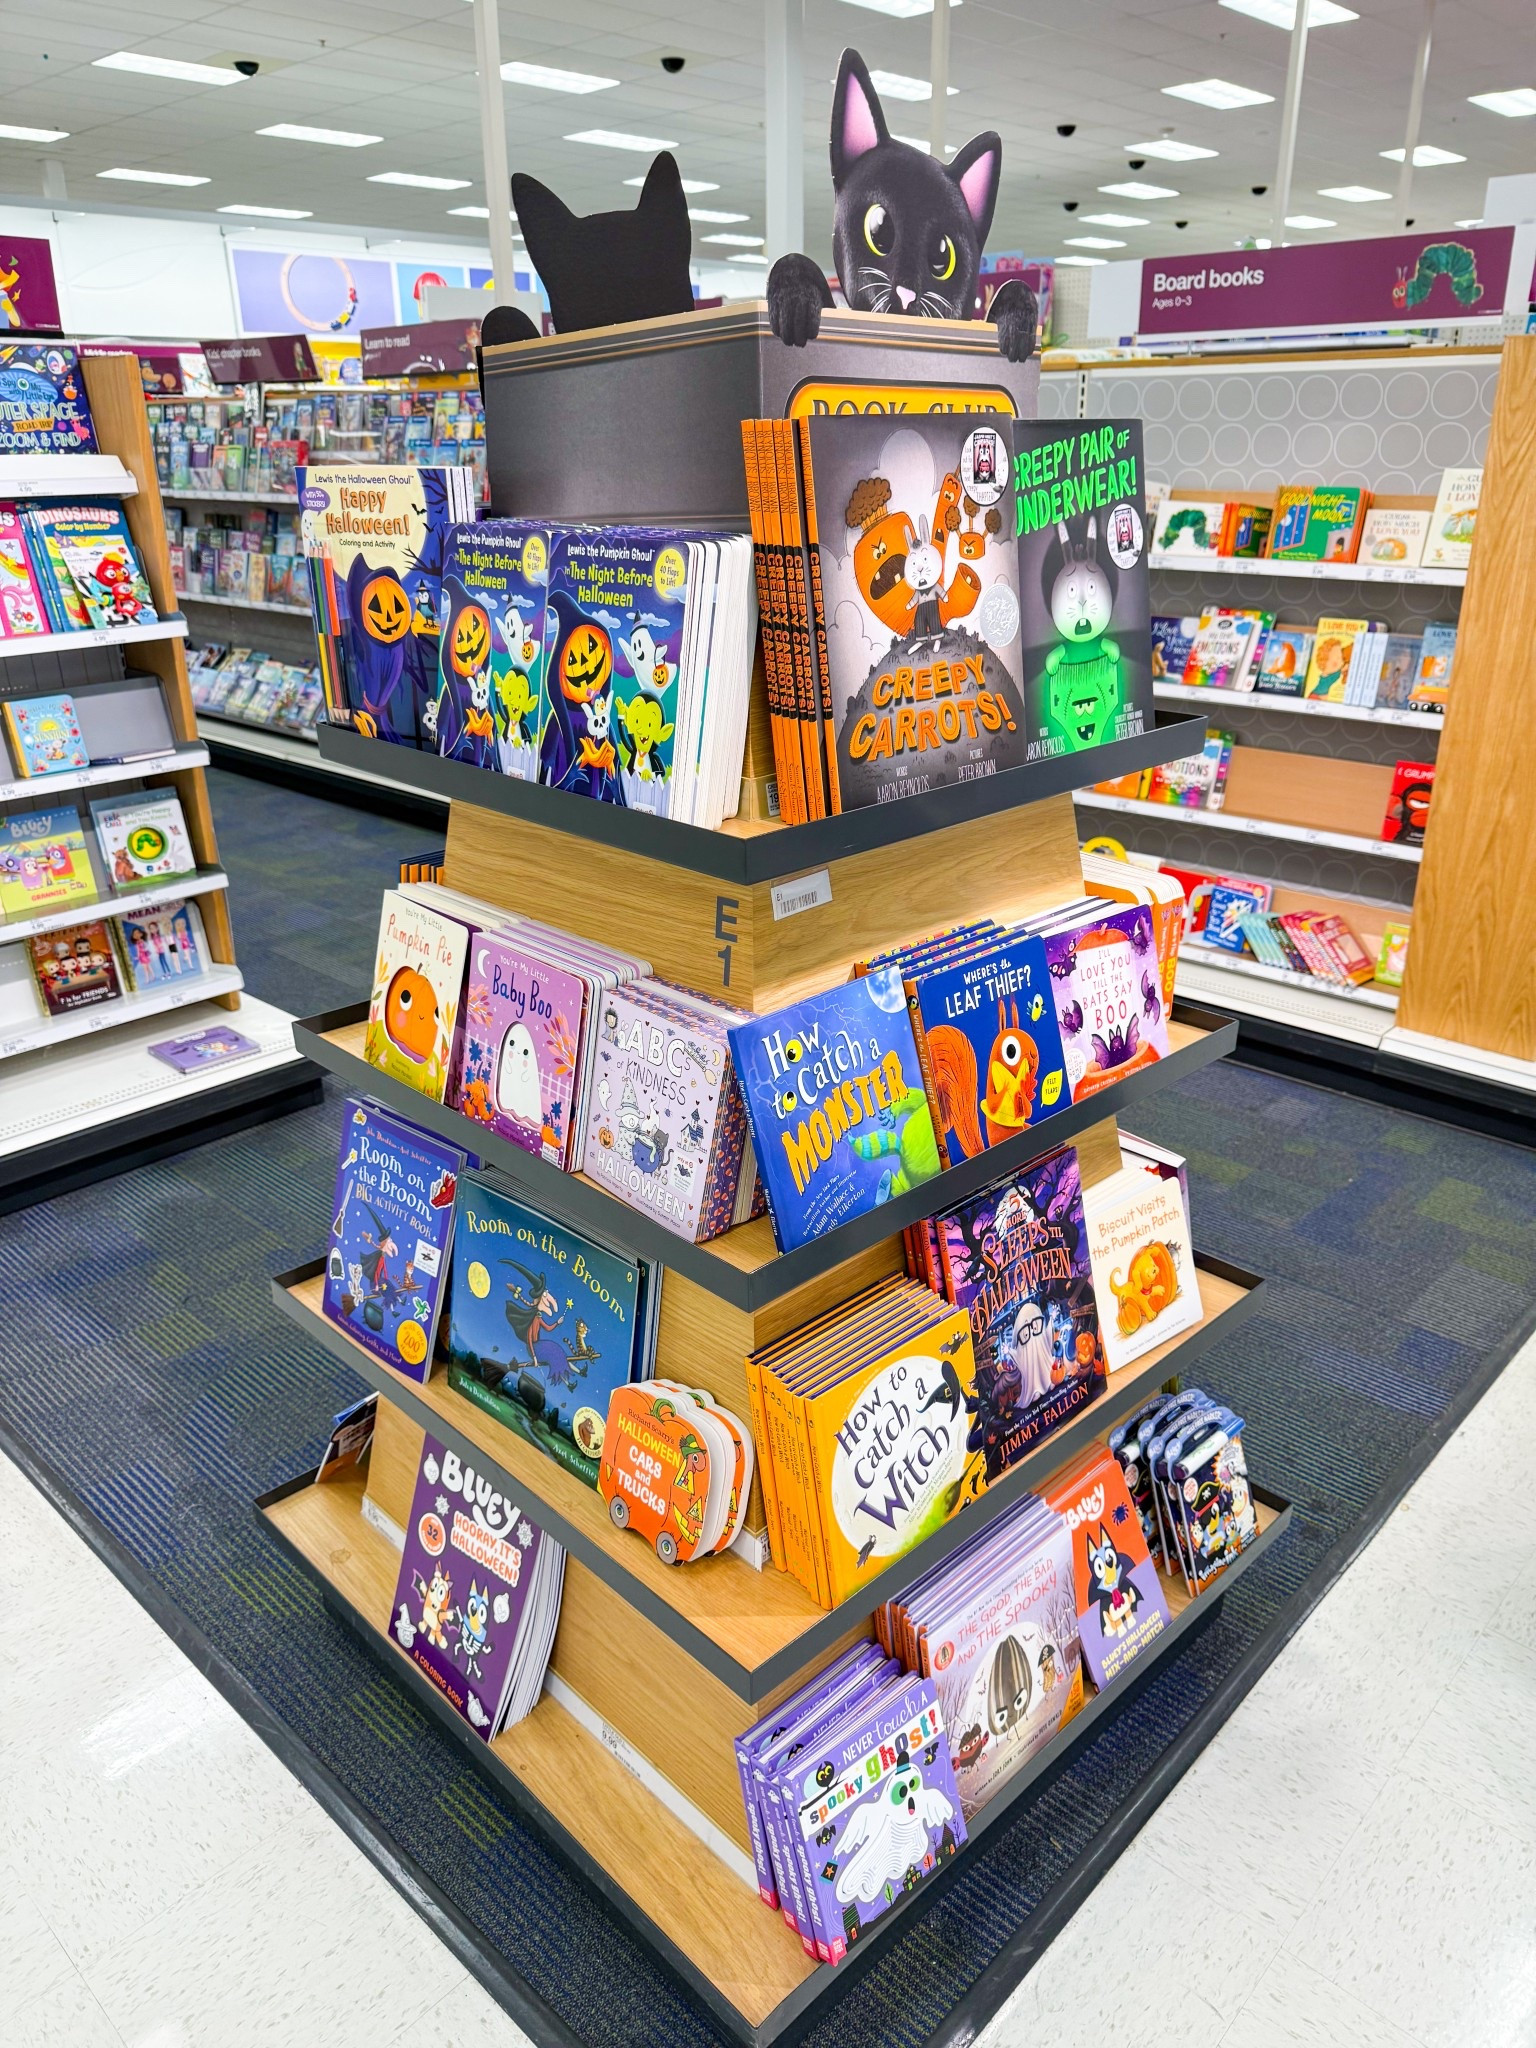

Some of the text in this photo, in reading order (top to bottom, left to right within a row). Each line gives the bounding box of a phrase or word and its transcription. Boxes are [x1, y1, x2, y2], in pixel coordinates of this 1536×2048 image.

[1153, 267, 1264, 293] Board books
[1152, 297, 1174, 310] Ages
[364, 334, 410, 351] Learn to read
[15, 421, 37, 431] ROAD
[30, 401, 80, 421] SPACE
[52, 431, 81, 448] FIND
[1080, 425, 1115, 470] PAIR
[1117, 429, 1130, 450] OF
[37, 506, 120, 526] DINOSAURS
[339, 487, 387, 513] Happy
[1279, 492, 1346, 507] GOODNIGHT
[1311, 508, 1345, 524] MOON
[55, 522, 111, 533] Color by Number
[325, 512, 411, 536] Halloween!
[339, 538, 361, 548] Coloring
[375, 538, 395, 550] Activity
[530, 543, 540, 551] Over
[567, 543, 586, 558] Lewis
[587, 545, 599, 558] the
[599, 546, 630, 562] Pumpkin
[665, 555, 677, 565] Over
[464, 570, 507, 590] Halloween
[570, 561, 587, 581] The
[588, 563, 615, 586] Night
[617, 566, 653, 588] Before
[659, 565, 680, 578] 40 Flaps
[660, 577, 676, 588] to Lift!
[577, 585, 633, 608] Halloween
[810, 552, 832, 713] CREEPY CARROTS!
[871, 654, 986, 707] CREEPY
[848, 690, 1017, 762] CARROTS!
[31, 888, 68, 902] GRANNIES
[127, 904, 161, 921] MEAN
[405, 907, 443, 932] You're My Little
[715, 896, 739, 943] E
[386, 912, 453, 967] Pumpkin Pie
[500, 954, 550, 985] You're My Little
[717, 945, 732, 987] 1
[963, 958, 1012, 985] WHERE'S the
[1079, 952, 1132, 982] LOVE YOU
[1092, 973, 1123, 990] TILL THE
[1164, 956, 1176, 993] BOO
[491, 963, 553, 1020] Baby Boo
[945, 964, 1032, 1019] LEAF THIEF?
[1083, 979, 1134, 1010] BATS SAY
[1095, 1000, 1128, 1031] BOO
[624, 1018, 691, 1078] ABCs
[762, 1021, 821, 1083] How
[772, 1030, 882, 1120] to Catch a
[1047, 1077, 1057, 1086] FELT
[781, 1050, 910, 1196] MONSTER
[359, 1135, 426, 1193] Room on
[358, 1165, 433, 1222] the Broom
[596, 1150, 686, 1222] HALLOWEEN
[1006, 1191, 1022, 1215] 5
[355, 1183, 432, 1241] BIG ACTIVITY BOOK
[812, 1182, 856, 1236] Adam Wallace &
[1005, 1211, 1028, 1231] MORE
[1098, 1194, 1167, 1239] Biscuit Visits
[938, 1224, 948, 1253] FALLON
[980, 1214, 1049, 1285] SLEEPS
[1092, 1207, 1181, 1262] the Pumpkin Patch
[466, 1209, 626, 1323] Room on the Broom
[970, 1246, 1073, 1345] HALLOWEEN
[403, 1333, 421, 1353] 200
[628, 1408, 675, 1445] Richard Scarry's
[834, 1366, 907, 1458] How to
[999, 1381, 1090, 1465] JIMMY FALLON
[617, 1412, 682, 1469] HALLOWEEN
[853, 1376, 929, 1490] Catch a
[628, 1445, 662, 1480] CARS
[634, 1469, 651, 1486] and
[853, 1424, 951, 1532] Witch
[617, 1467, 666, 1517] TRUCKS
[427, 1524, 439, 1541] 32
[455, 1513, 520, 1567] HOORAY, IT'S
[452, 1528, 519, 1585] HALLOWEEN!
[956, 1570, 1057, 1667] AND THE SPOOKY
[957, 1558, 1054, 1643] THE GOOD, THE BAD,
[1100, 1609, 1161, 1670] BLUEY'S HALLOWEEN
[1104, 1621, 1165, 1683] MIX-AND-MATCH
[414, 1650, 464, 1709] A COLORING BOOK
[842, 1690, 928, 1765] NEVER touch A
[809, 1708, 939, 1825] spooky ghost!
[797, 1843, 823, 1929] spooky ghost!
